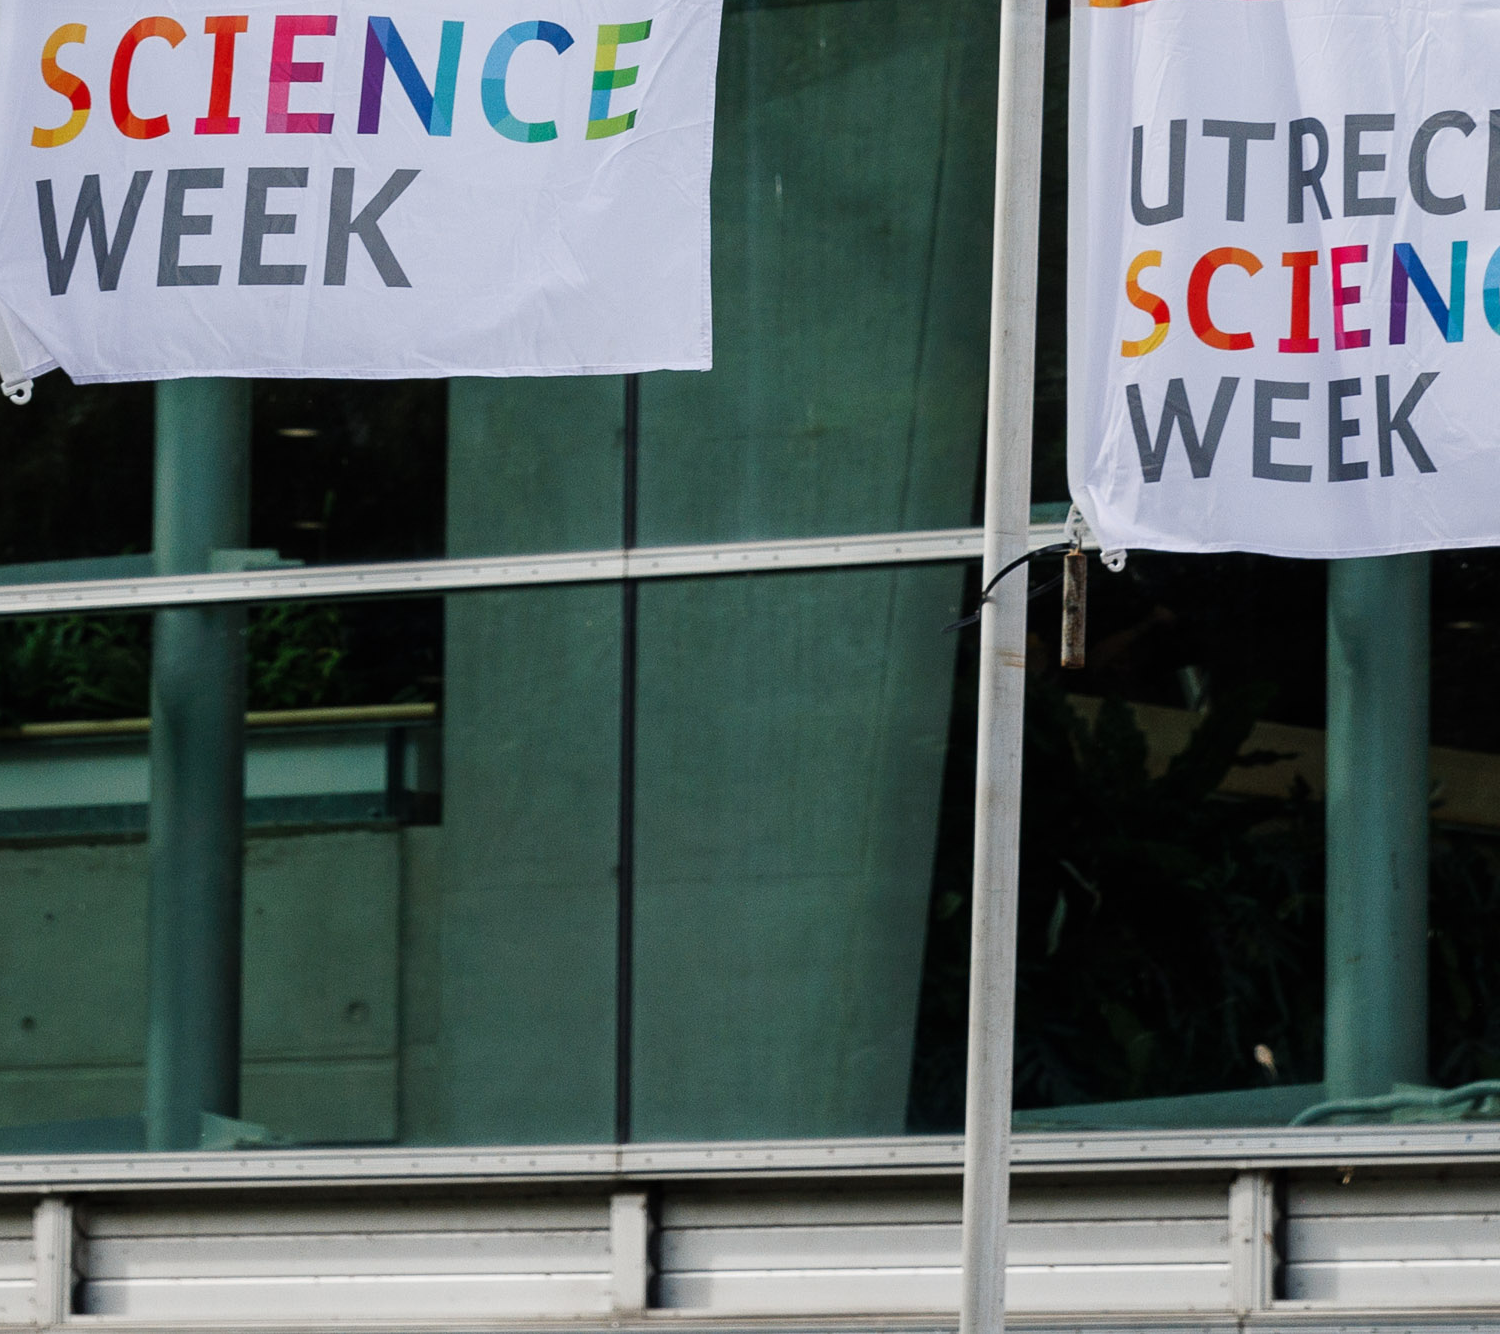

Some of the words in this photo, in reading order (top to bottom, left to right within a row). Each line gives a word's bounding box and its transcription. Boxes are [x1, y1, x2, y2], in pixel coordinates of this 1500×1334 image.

[30, 15, 653, 148] SCIENCE
[36, 166, 422, 297] WEEK
[1126, 372, 1440, 483] WEEK
